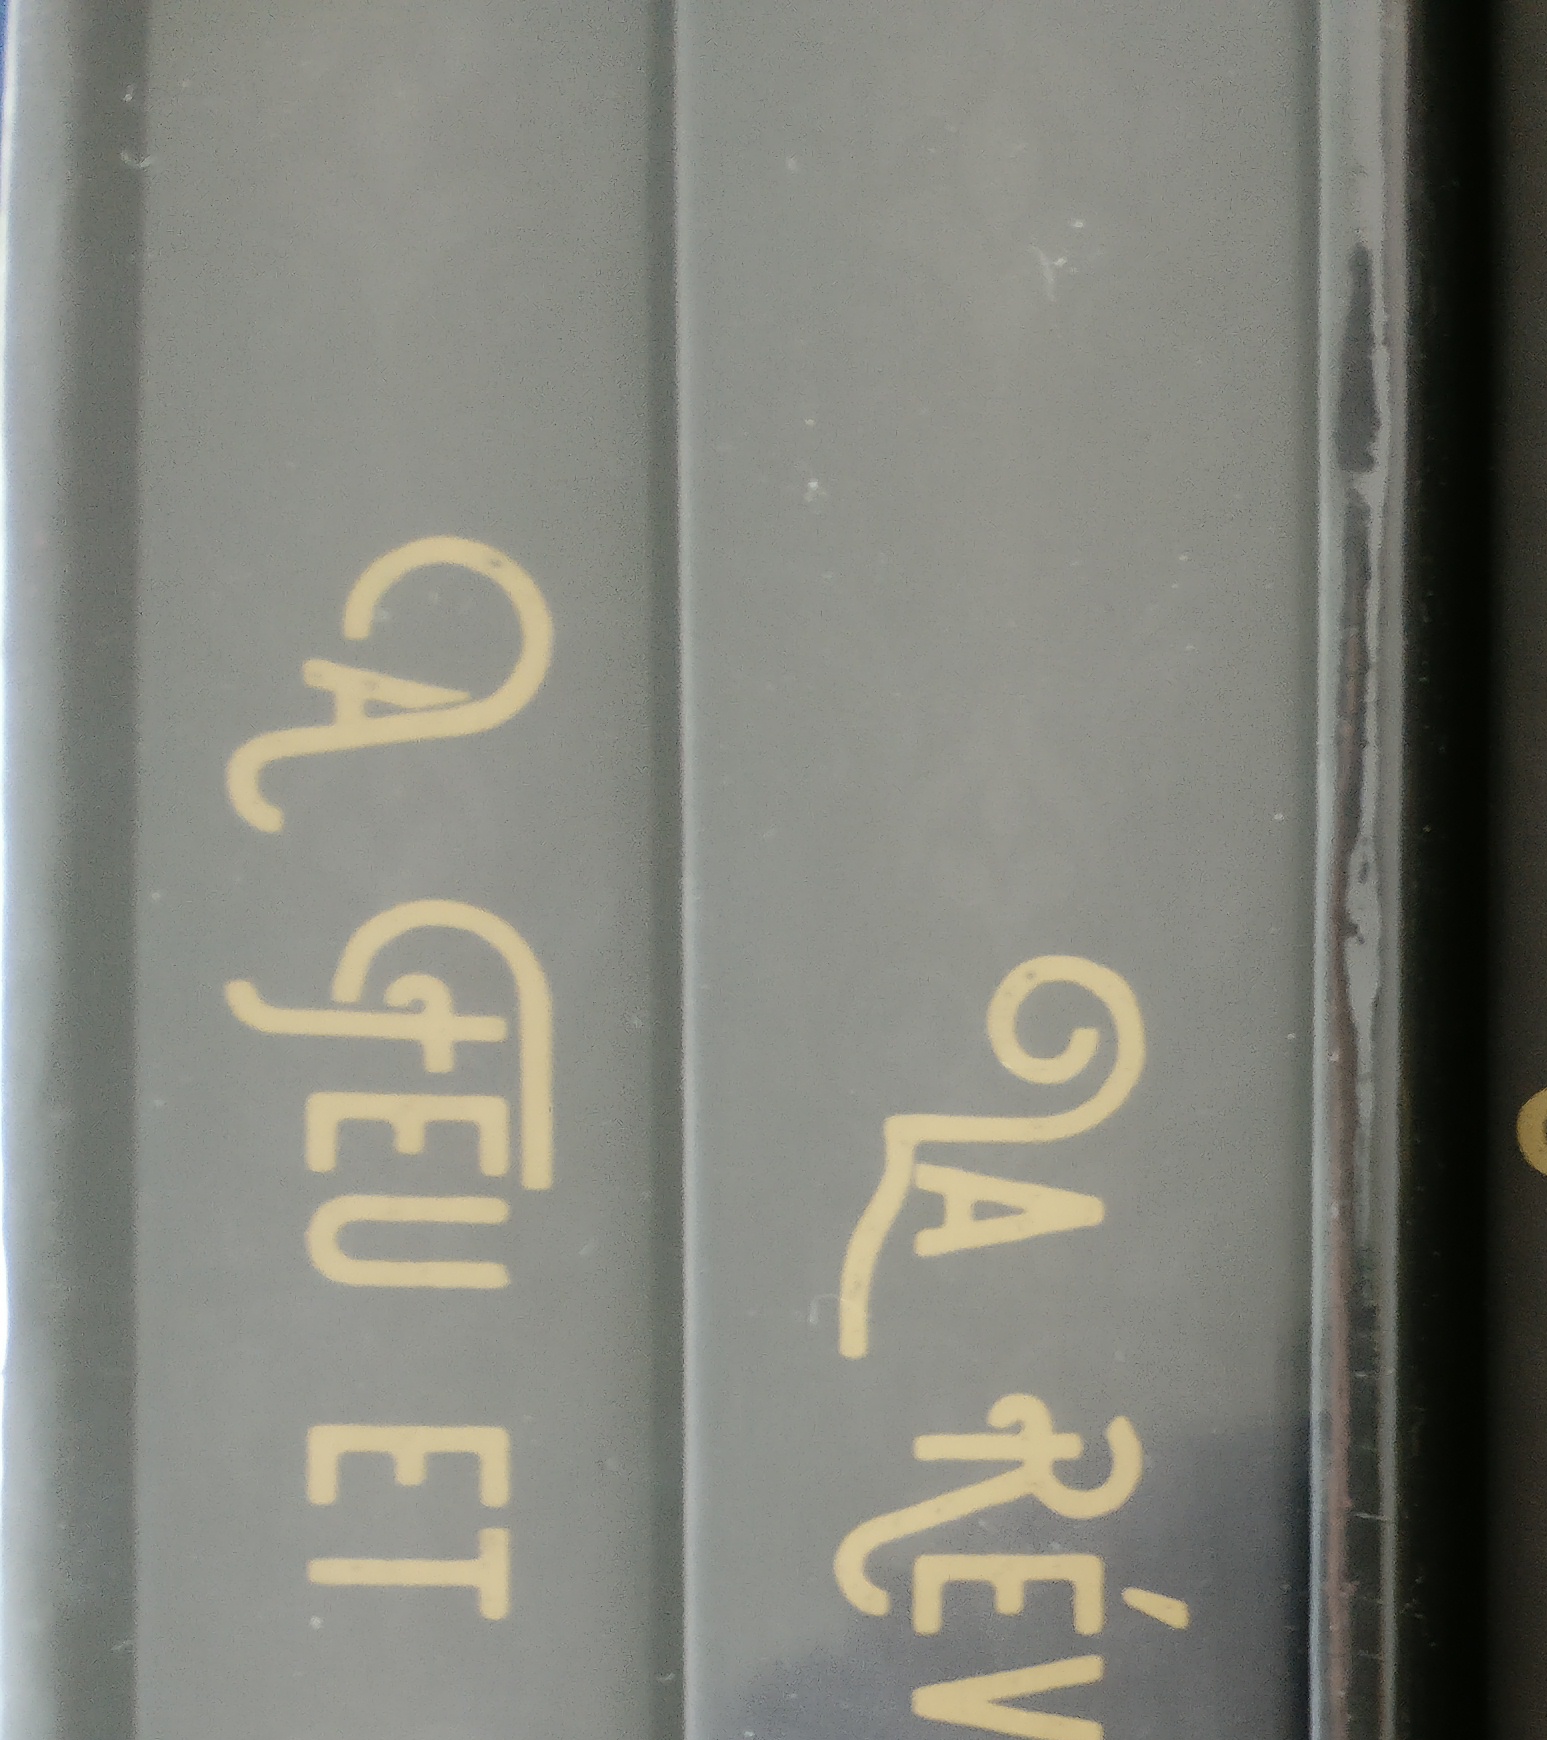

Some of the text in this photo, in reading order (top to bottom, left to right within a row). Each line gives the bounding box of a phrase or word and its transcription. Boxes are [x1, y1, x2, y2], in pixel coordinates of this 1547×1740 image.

[229, 536, 553, 833] A
[227, 899, 554, 1289] FEU
[839, 955, 1147, 1360] LA
[308, 1424, 510, 1621] ET
